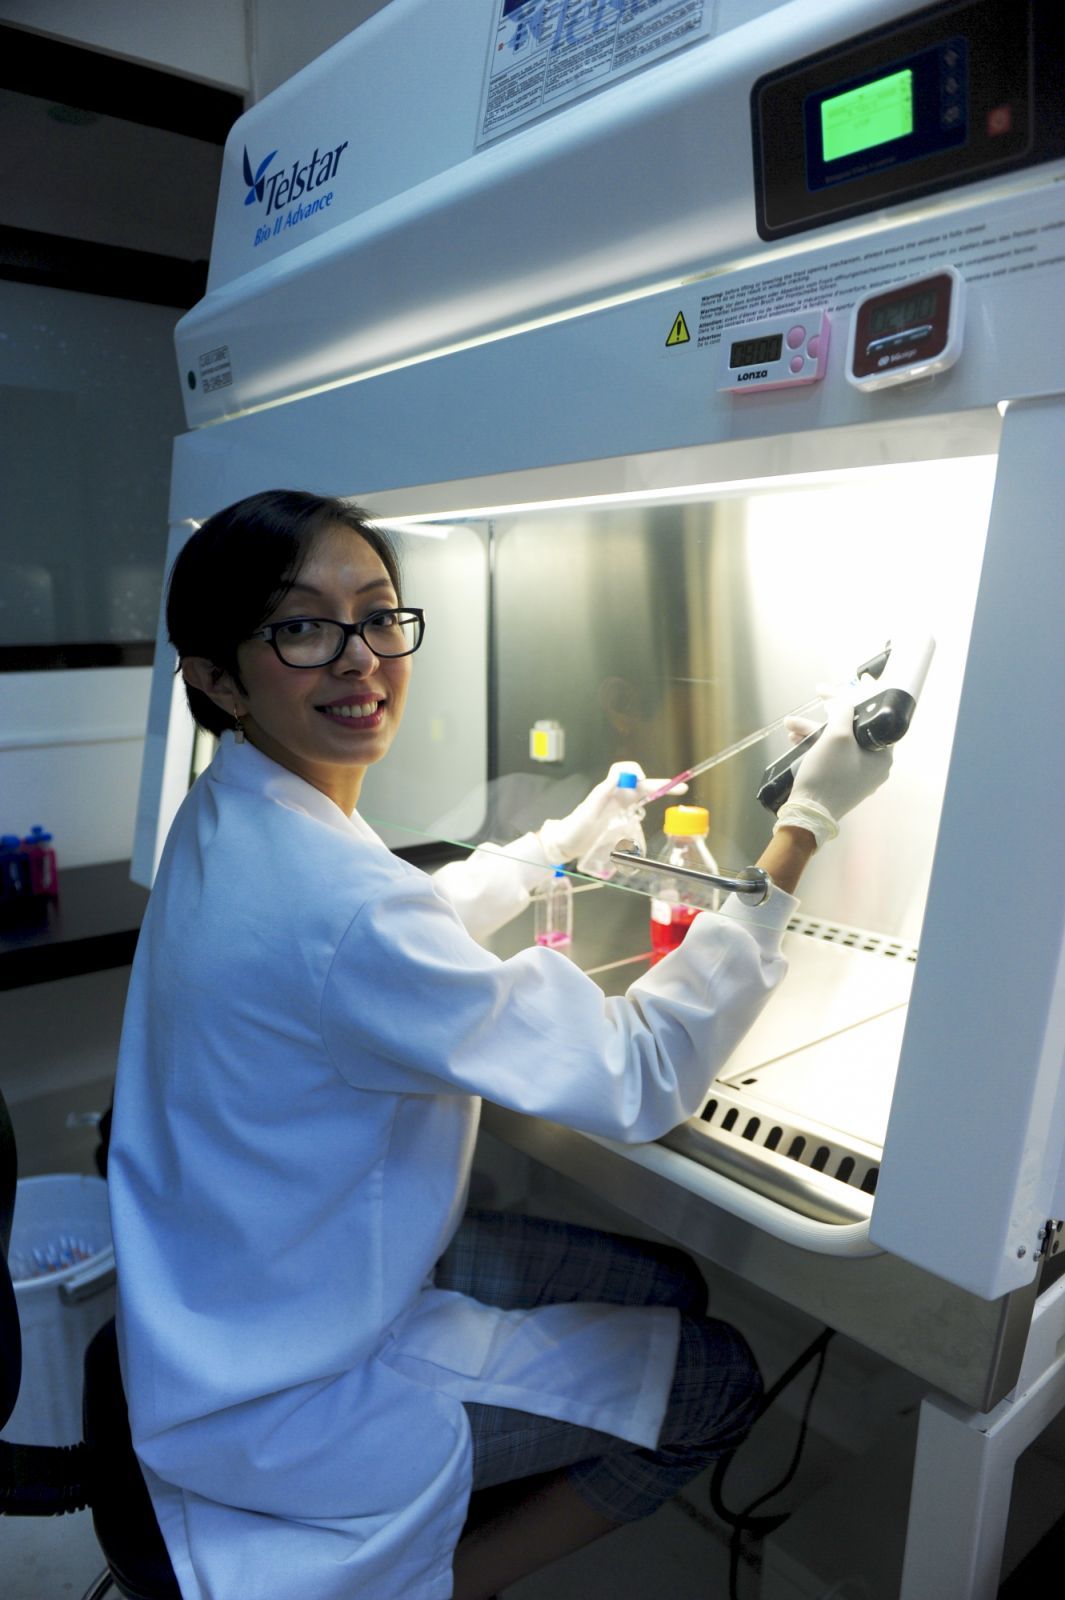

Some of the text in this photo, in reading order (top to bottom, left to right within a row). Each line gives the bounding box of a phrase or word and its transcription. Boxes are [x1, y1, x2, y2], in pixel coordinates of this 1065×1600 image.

[266, 140, 349, 216] Telstar
[253, 224, 272, 247] Bio
[283, 191, 334, 231] Advance
